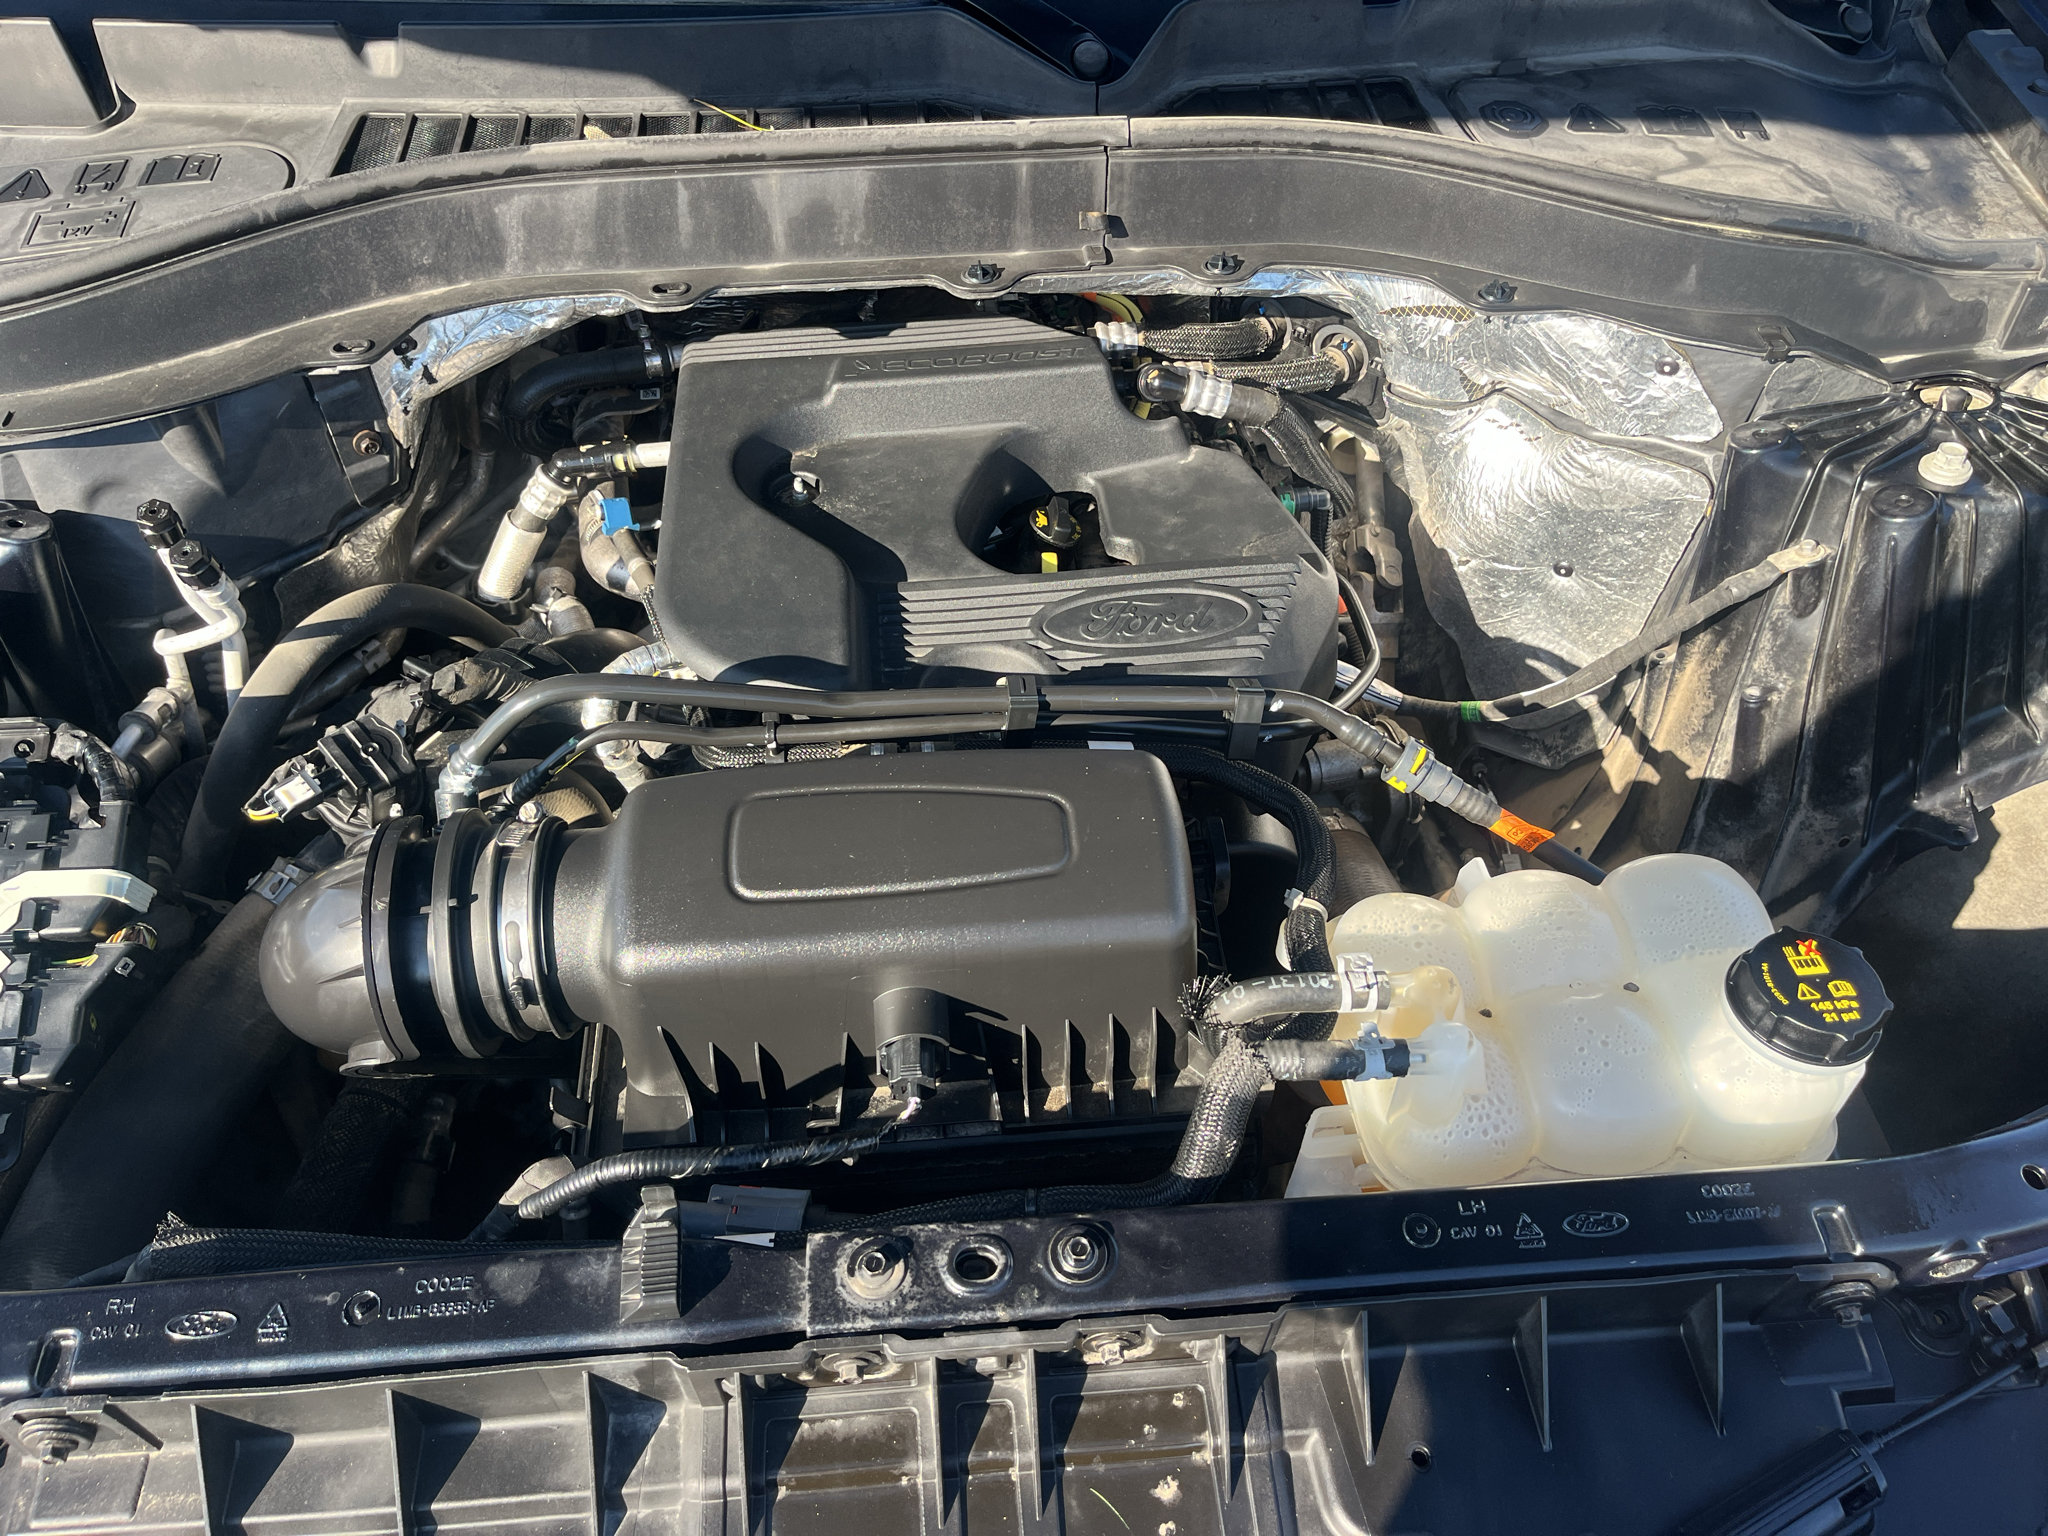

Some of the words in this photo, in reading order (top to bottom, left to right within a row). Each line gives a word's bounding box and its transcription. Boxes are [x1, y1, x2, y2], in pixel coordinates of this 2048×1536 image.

[881, 347, 1085, 372] ECOBOOST
[1080, 600, 1215, 640] Ford
[1810, 1001, 1833, 1011] 145
[1834, 999, 1860, 1010] kPa
[1823, 1012, 1839, 1022] 21
[1840, 1010, 1861, 1022] psi
[1456, 1200, 1487, 1216] LH
[1449, 1225, 1477, 1240] CAV
[105, 1297, 137, 1316] RH
